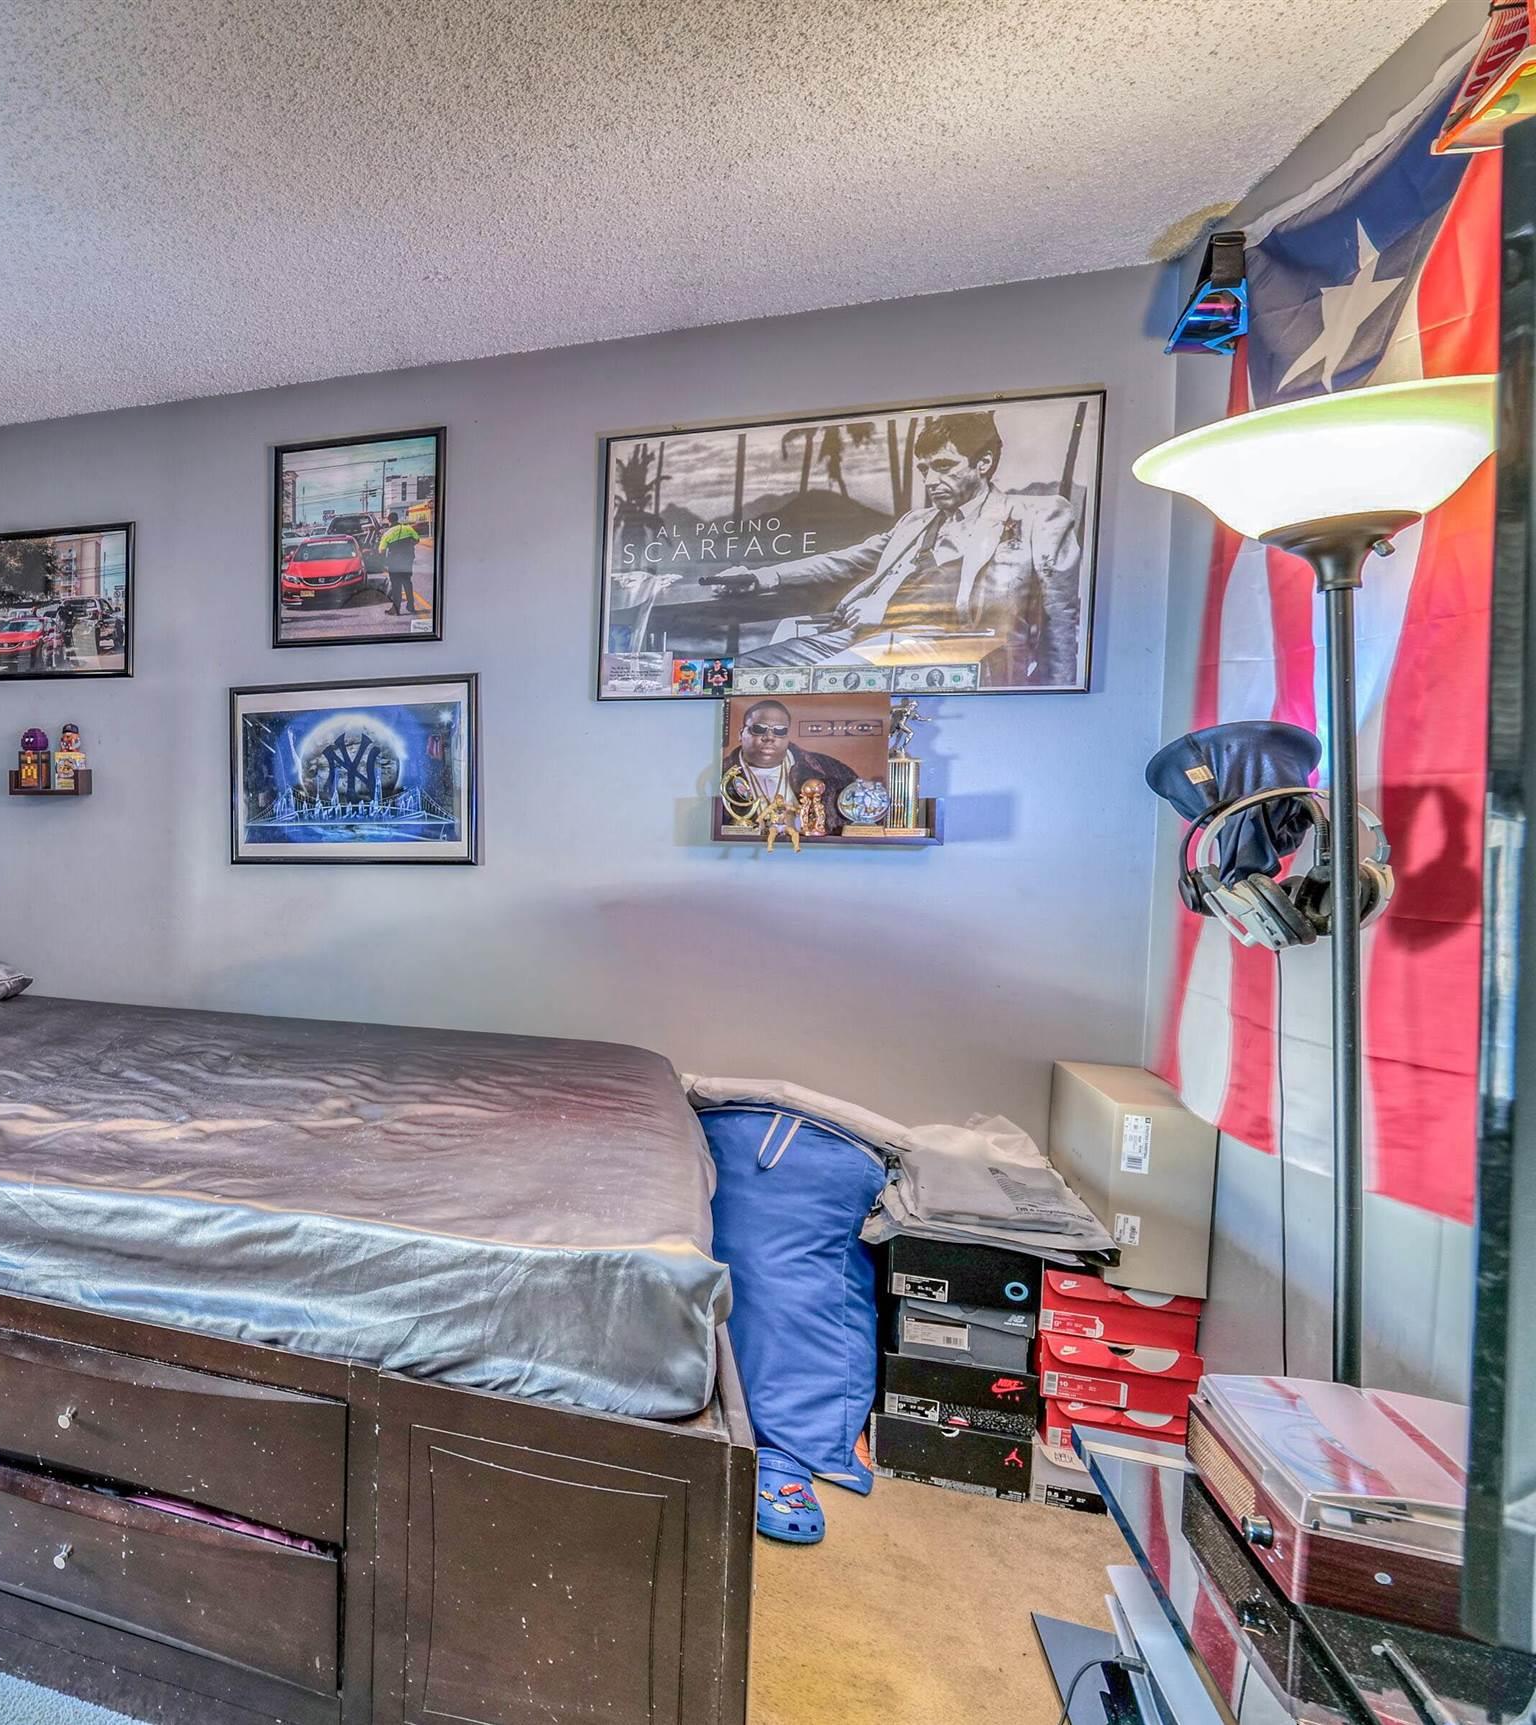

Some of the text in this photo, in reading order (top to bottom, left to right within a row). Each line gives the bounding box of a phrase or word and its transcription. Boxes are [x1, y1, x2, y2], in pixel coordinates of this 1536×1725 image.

[656, 517, 781, 539] AL PACINO
[623, 531, 817, 564] SCARFACE
[322, 732, 381, 802] NY
